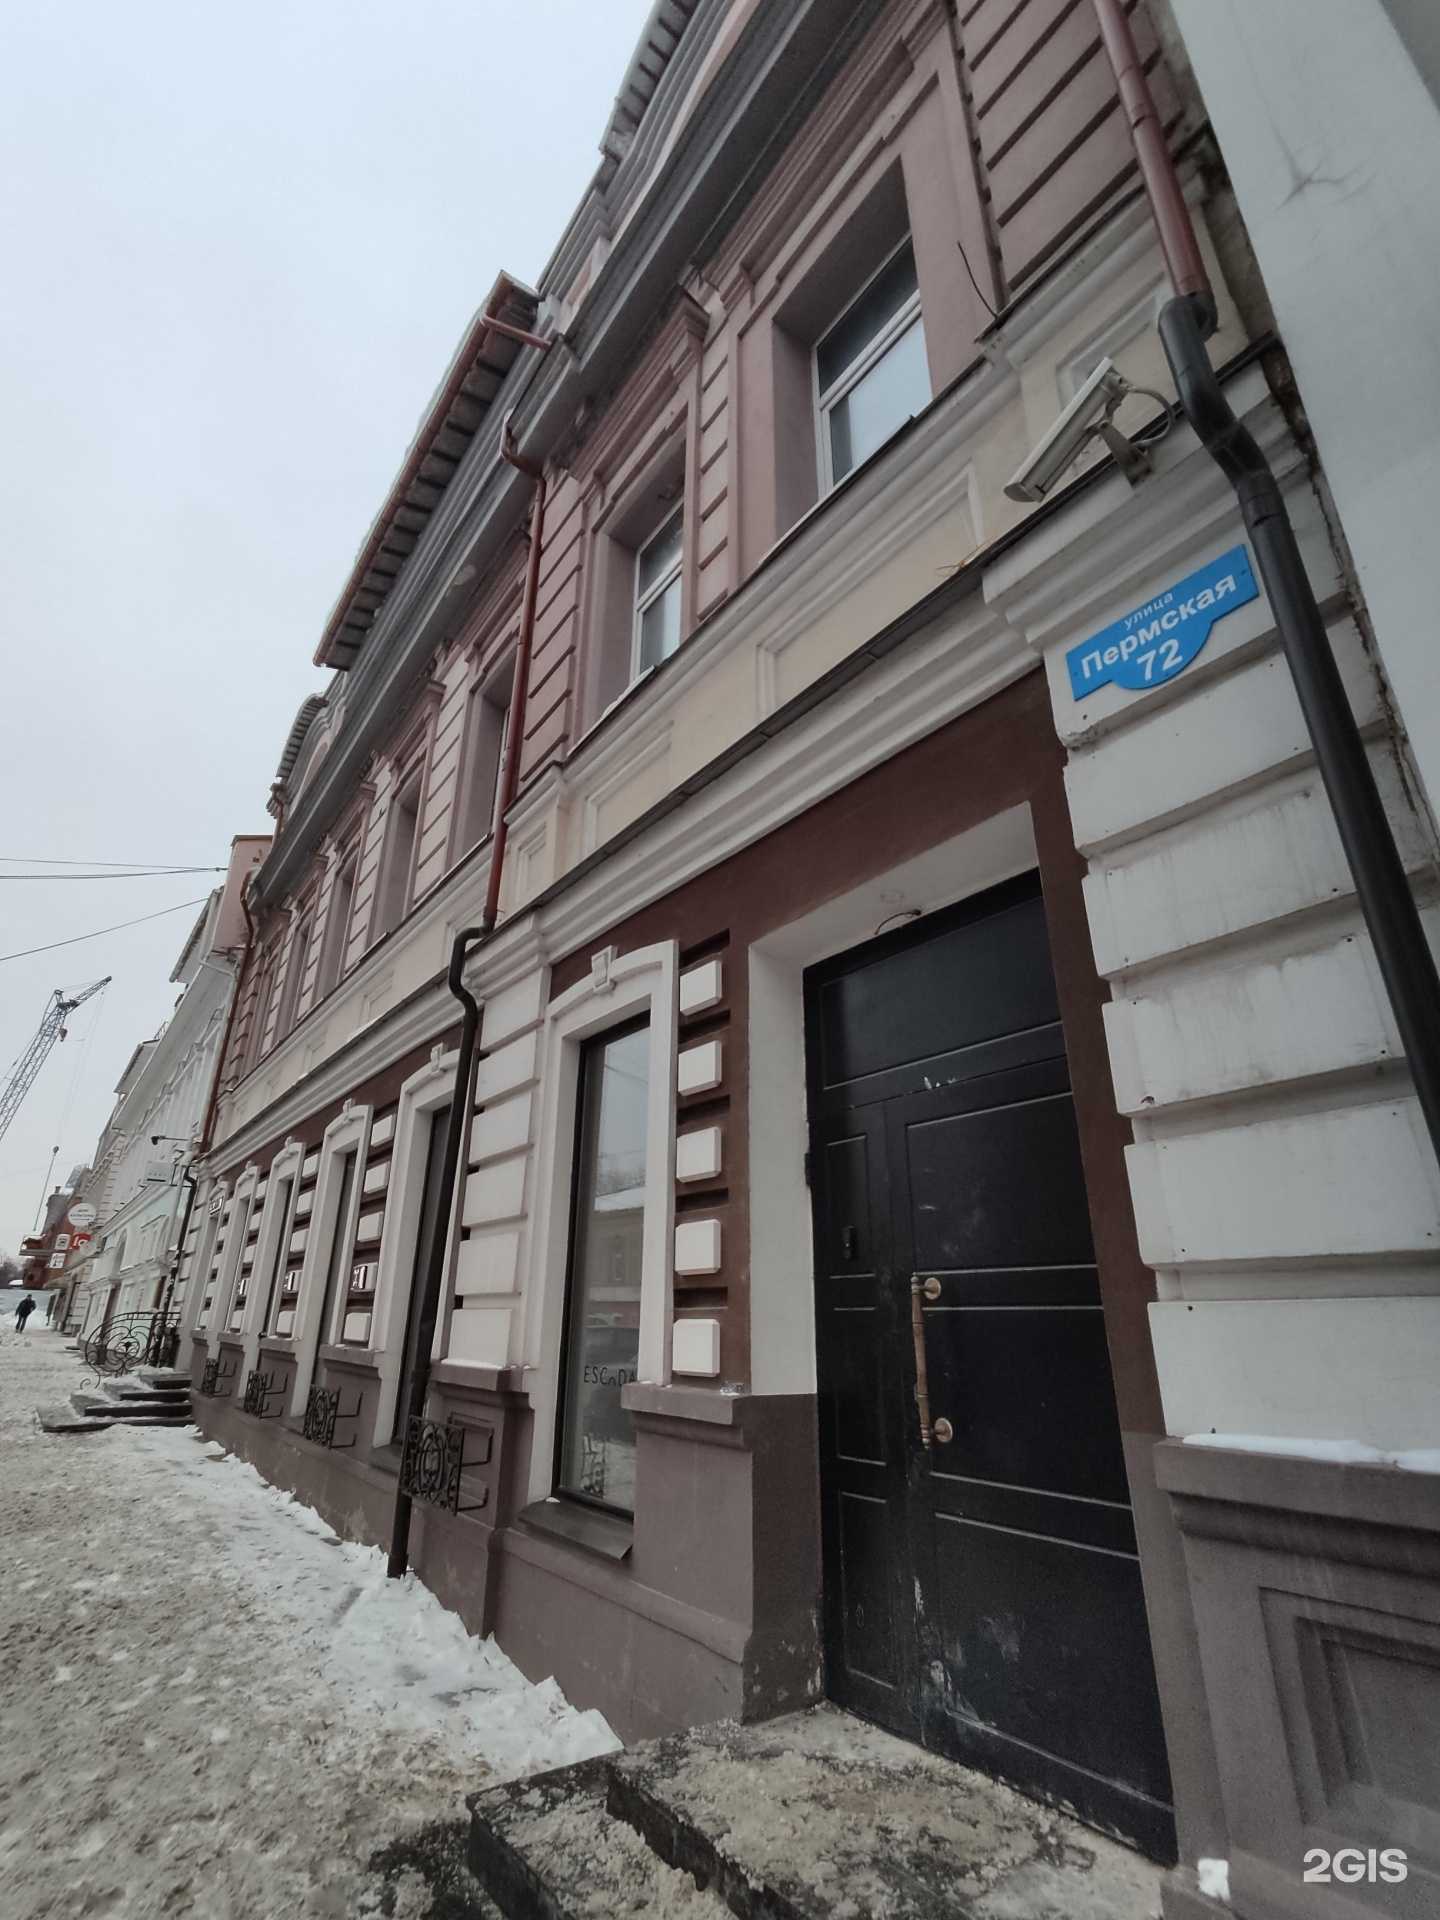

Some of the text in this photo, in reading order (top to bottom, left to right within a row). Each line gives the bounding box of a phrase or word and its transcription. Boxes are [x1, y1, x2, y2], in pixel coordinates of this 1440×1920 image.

[1081, 574, 1237, 679] Пермская
[1123, 592, 1174, 631] улица
[1137, 638, 1183, 681] 72
